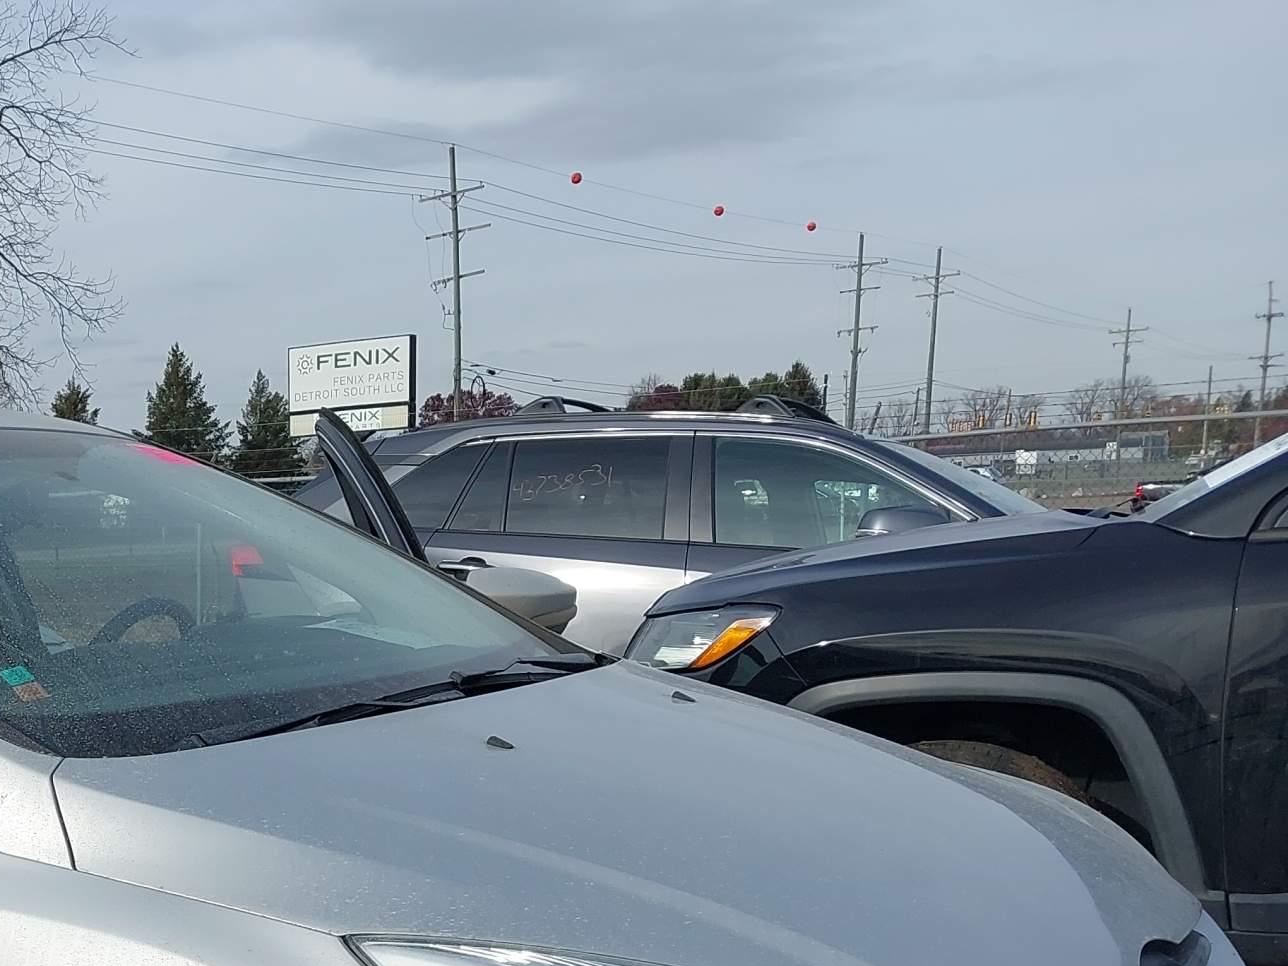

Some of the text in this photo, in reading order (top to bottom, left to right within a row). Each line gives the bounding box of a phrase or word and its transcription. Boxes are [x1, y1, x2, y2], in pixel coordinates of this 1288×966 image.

[316, 346, 401, 371] FENIX
[333, 370, 404, 387] FENIX PARTS
[294, 382, 404, 403] DETROIT SOUTH LLC
[339, 409, 380, 423] ENIX
